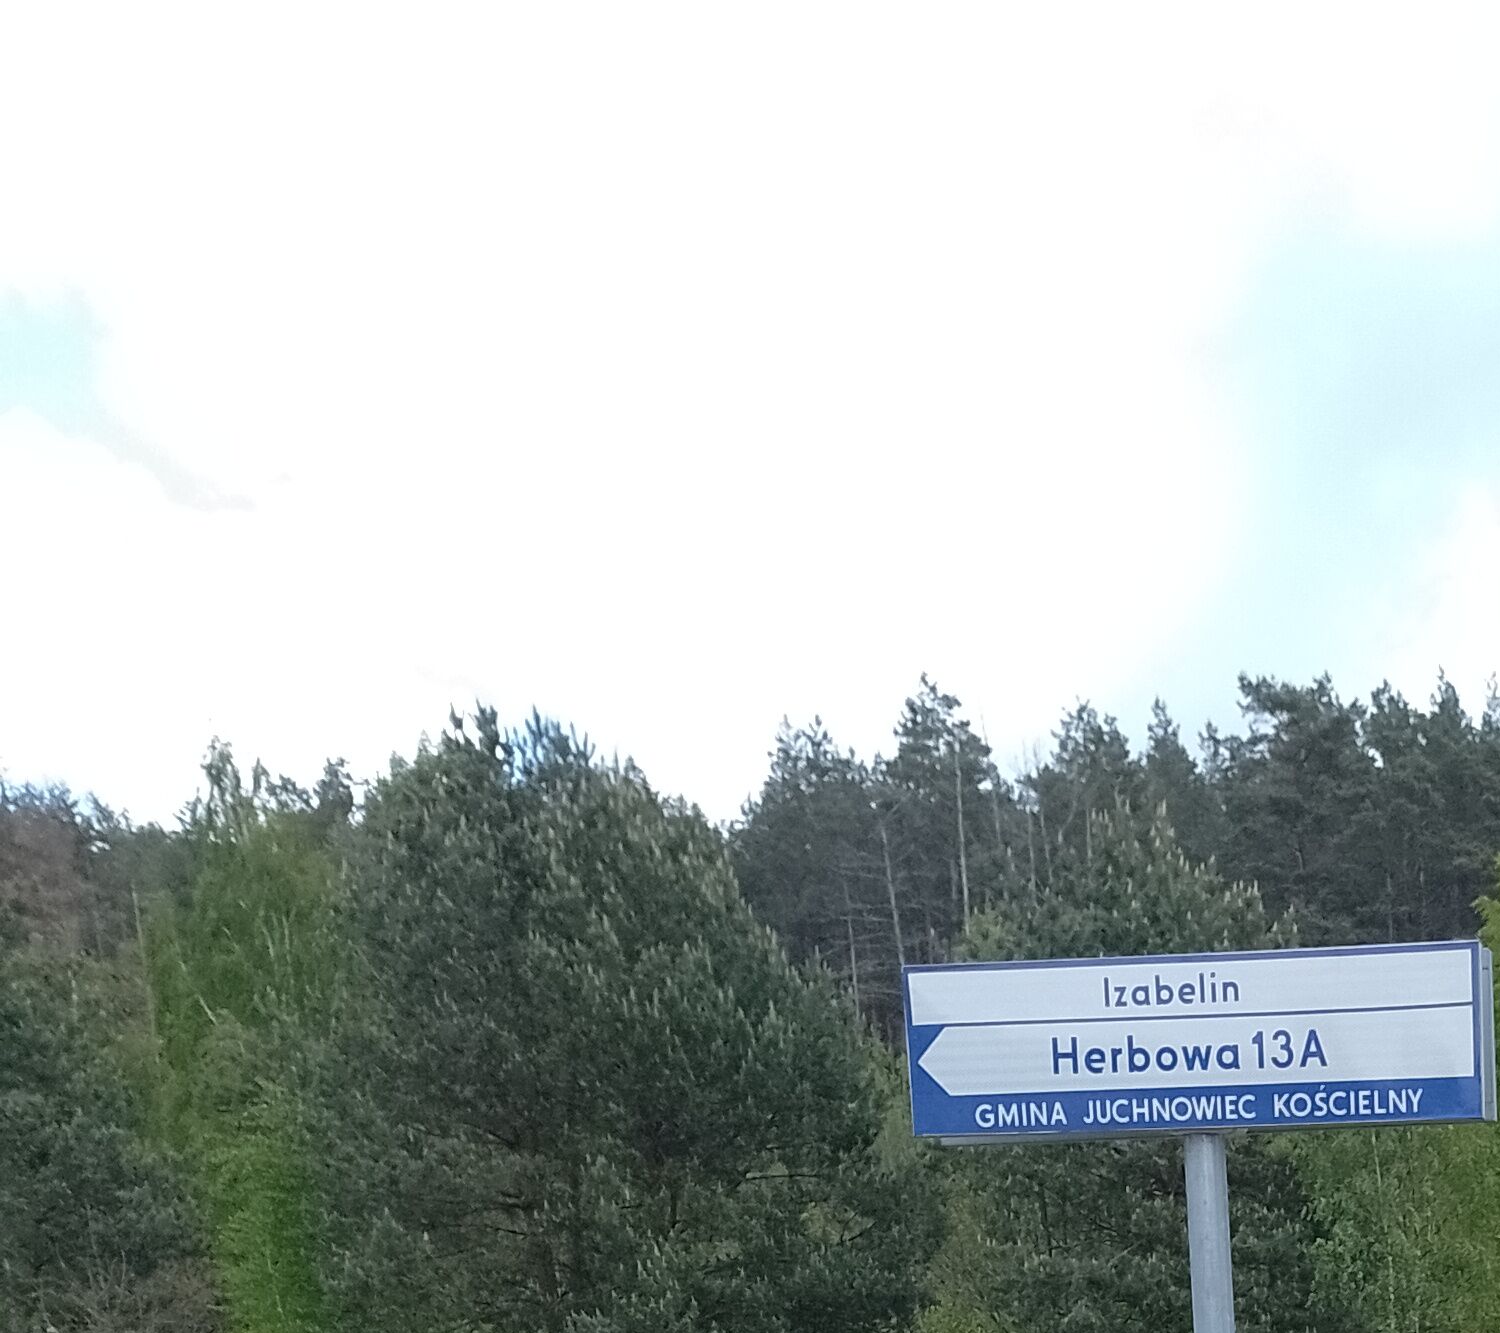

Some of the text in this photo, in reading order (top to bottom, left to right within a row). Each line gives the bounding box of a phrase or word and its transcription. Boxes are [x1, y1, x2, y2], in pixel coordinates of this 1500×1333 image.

[1103, 972, 1240, 1008] Izabelin
[1051, 1029, 1328, 1075] Herbowa 13A
[974, 1085, 1424, 1129] GMINA JUCHNOWIEC KOŚCIELNY
